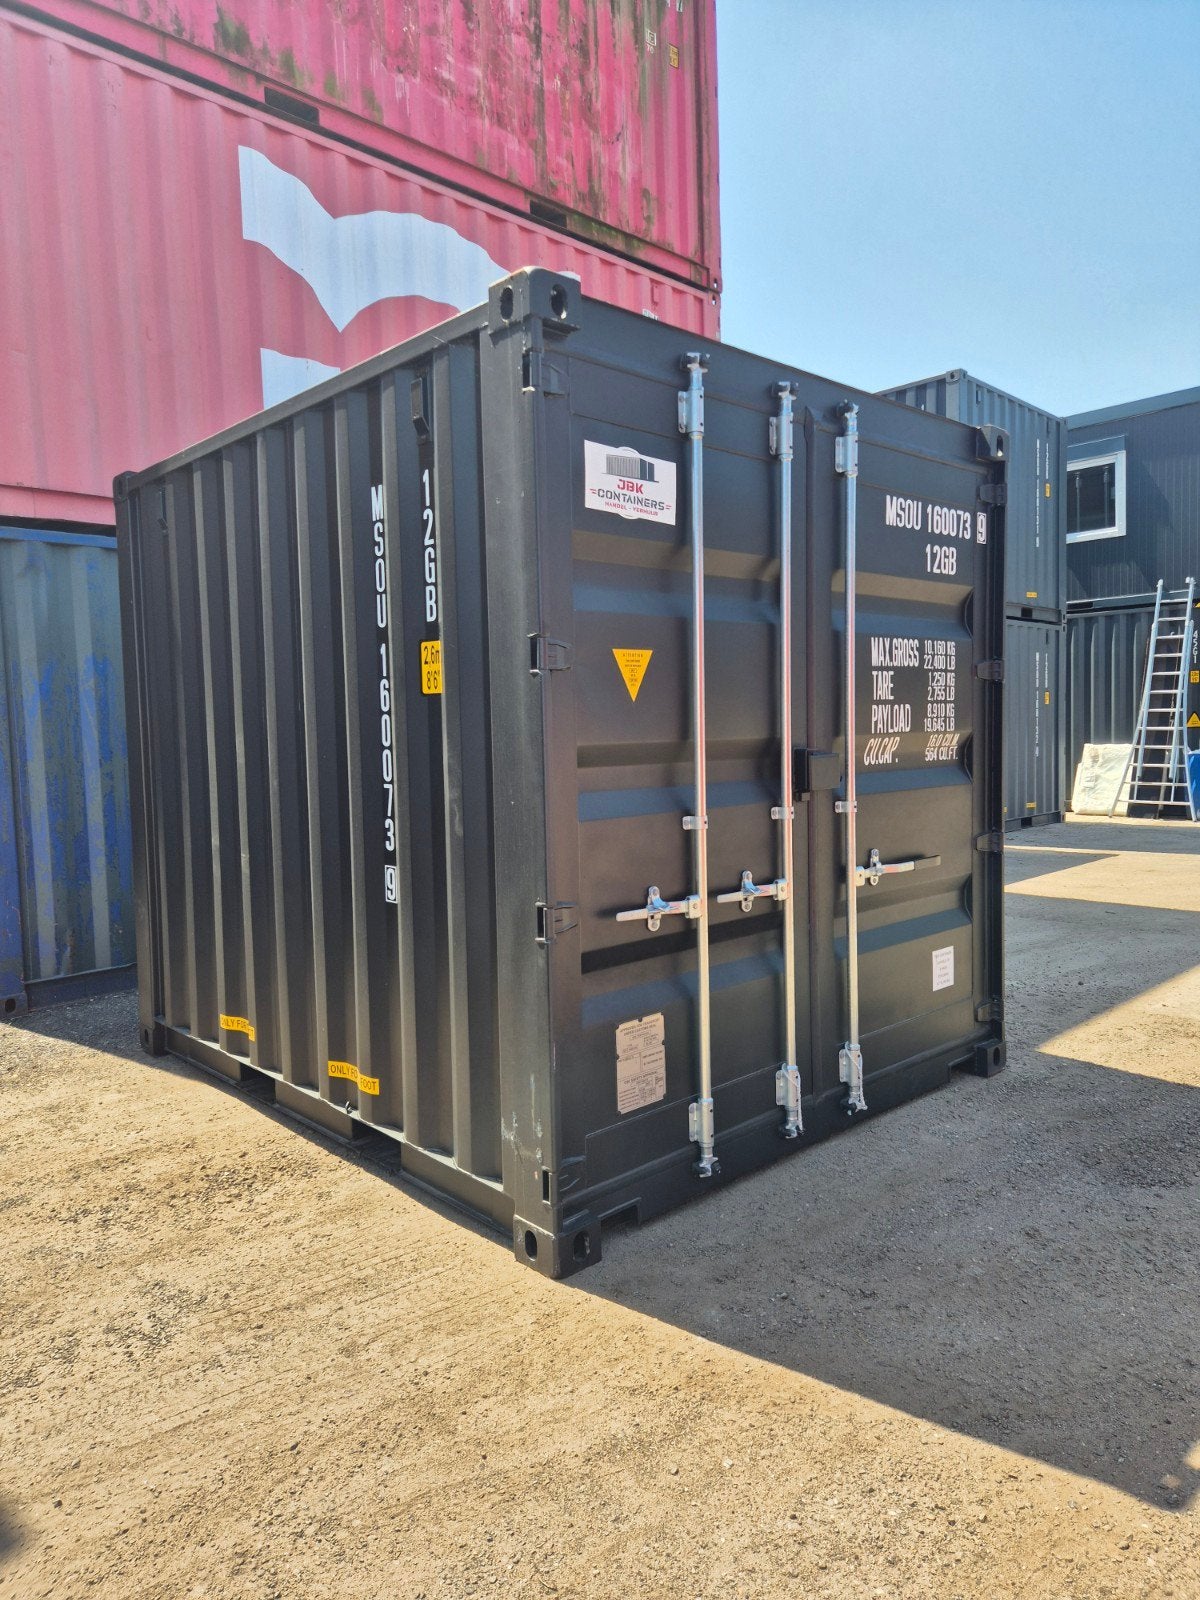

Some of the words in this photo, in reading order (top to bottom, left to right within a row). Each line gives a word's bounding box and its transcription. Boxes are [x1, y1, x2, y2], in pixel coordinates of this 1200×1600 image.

[598, 488, 665, 510] CONTAINERS
[618, 479, 643, 494] JBK
[886, 495, 922, 530] MSOU
[926, 504, 971, 539] 160073
[977, 512, 986, 544] 9
[370, 484, 386, 628] MSOU
[422, 469, 437, 622] 12GB
[926, 544, 957, 575] 12GB
[871, 637, 919, 666] MAX.GROSS
[947, 641, 956, 655] KG
[947, 656, 956, 670] LB
[872, 671, 894, 700] TARE
[946, 672, 956, 686] KG
[946, 686, 955, 700] LB
[872, 704, 911, 734] PAYLOAD
[946, 703, 955, 717] KG
[946, 718, 955, 732] LB
[379, 644, 394, 851] 160073
[385, 866, 398, 903] 9
[330, 1064, 350, 1076] ONLY
